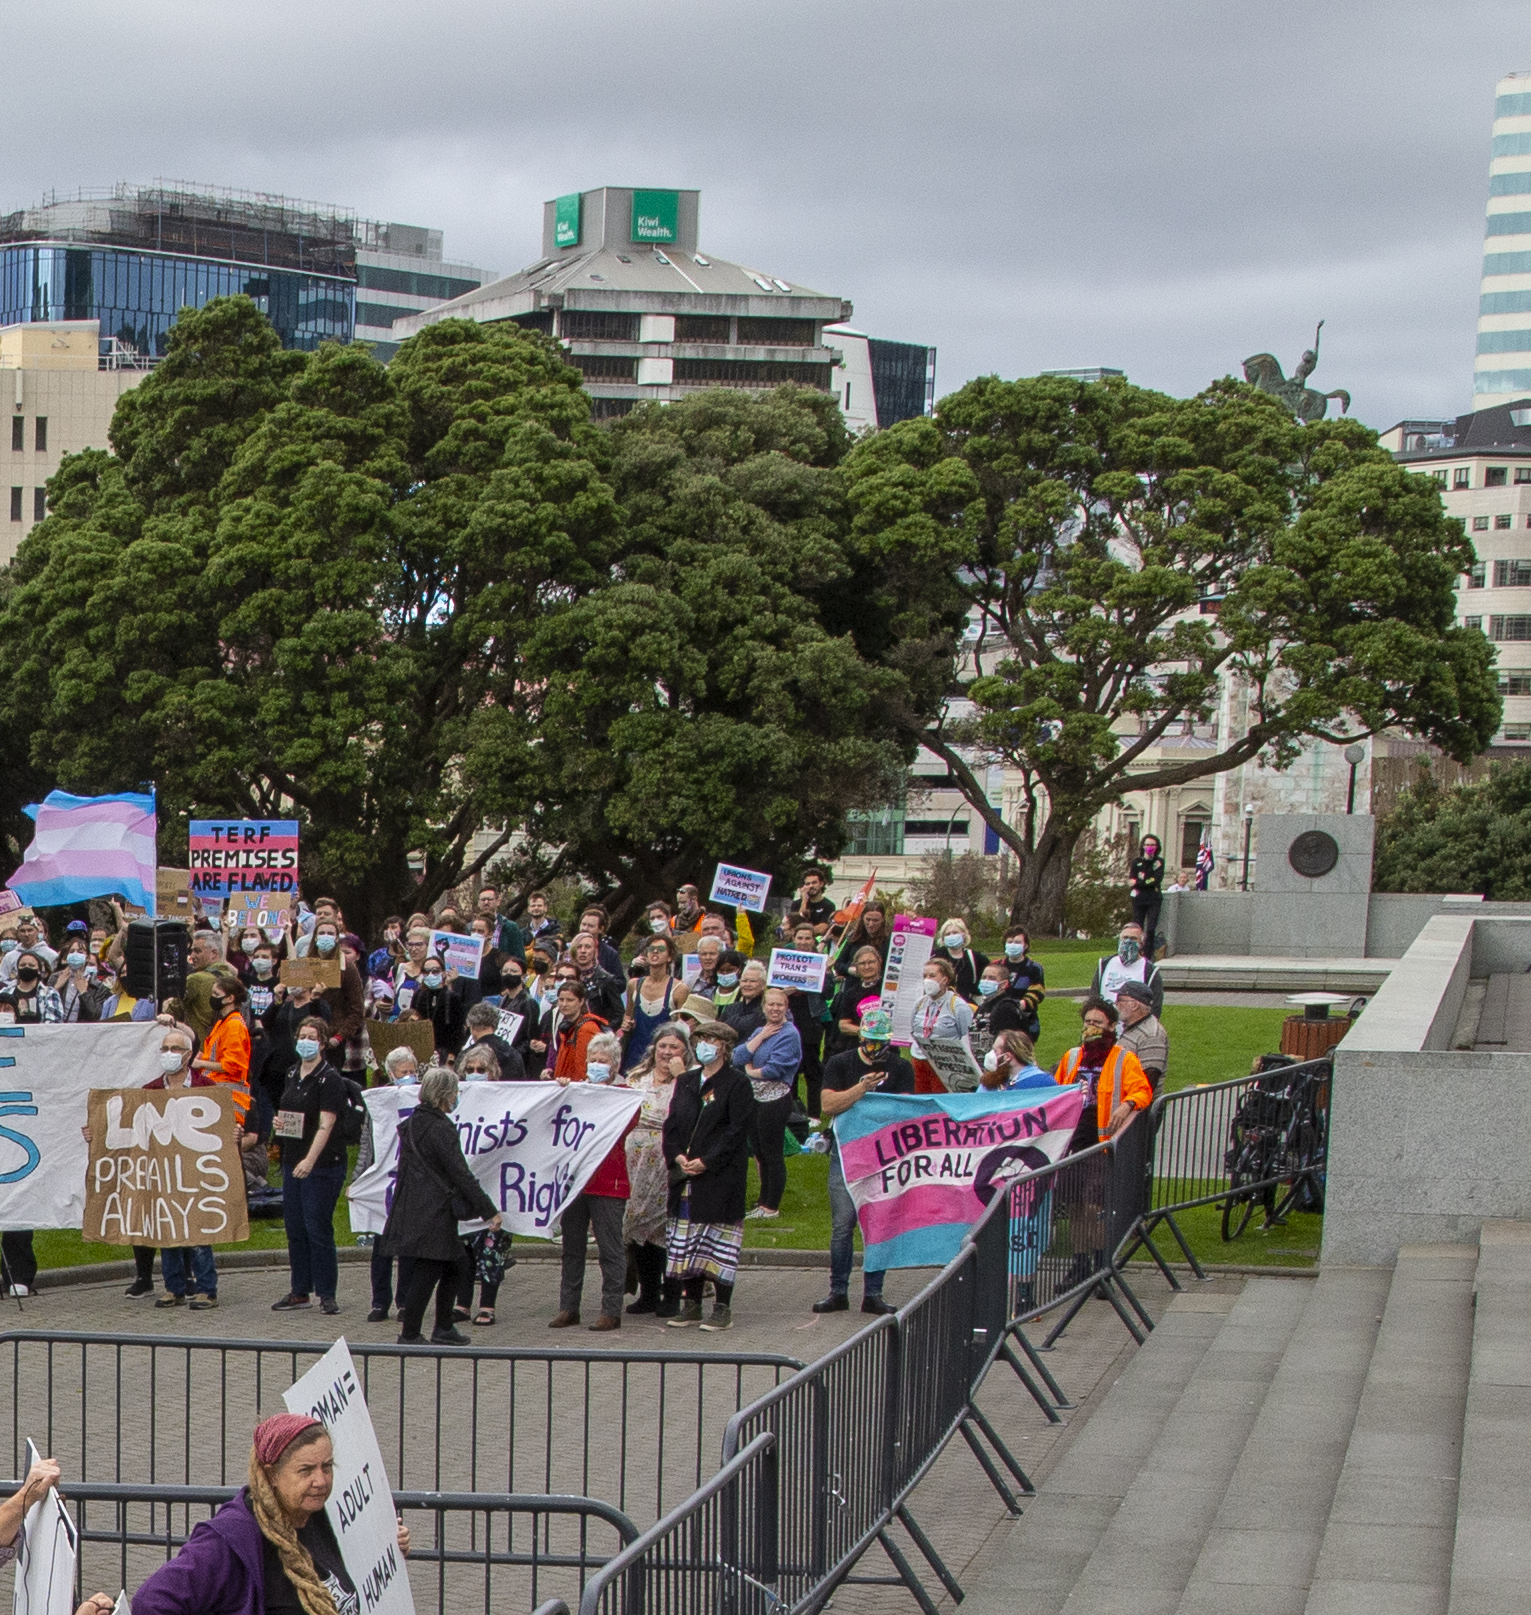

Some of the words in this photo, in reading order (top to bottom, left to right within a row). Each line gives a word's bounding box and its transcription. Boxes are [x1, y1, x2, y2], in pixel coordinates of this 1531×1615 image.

[638, 216, 659, 227] Kiwi
[638, 227, 672, 238] Wealth.
[211, 826, 271, 844] TERF
[191, 848, 296, 869] PREMISES
[191, 872, 222, 891] ARE
[724, 878, 761, 893] AGAINST
[244, 894, 270, 909] WE
[228, 910, 288, 927] BELONG
[780, 962, 808, 972] TRANS
[551, 1104, 596, 1151] for
[881, 1154, 933, 1194] FOR
[939, 1153, 974, 1179] ALL
[100, 1192, 227, 1240] ALWAYS
[336, 1463, 376, 1533] ADULT
[362, 1543, 398, 1614] HUMAN
